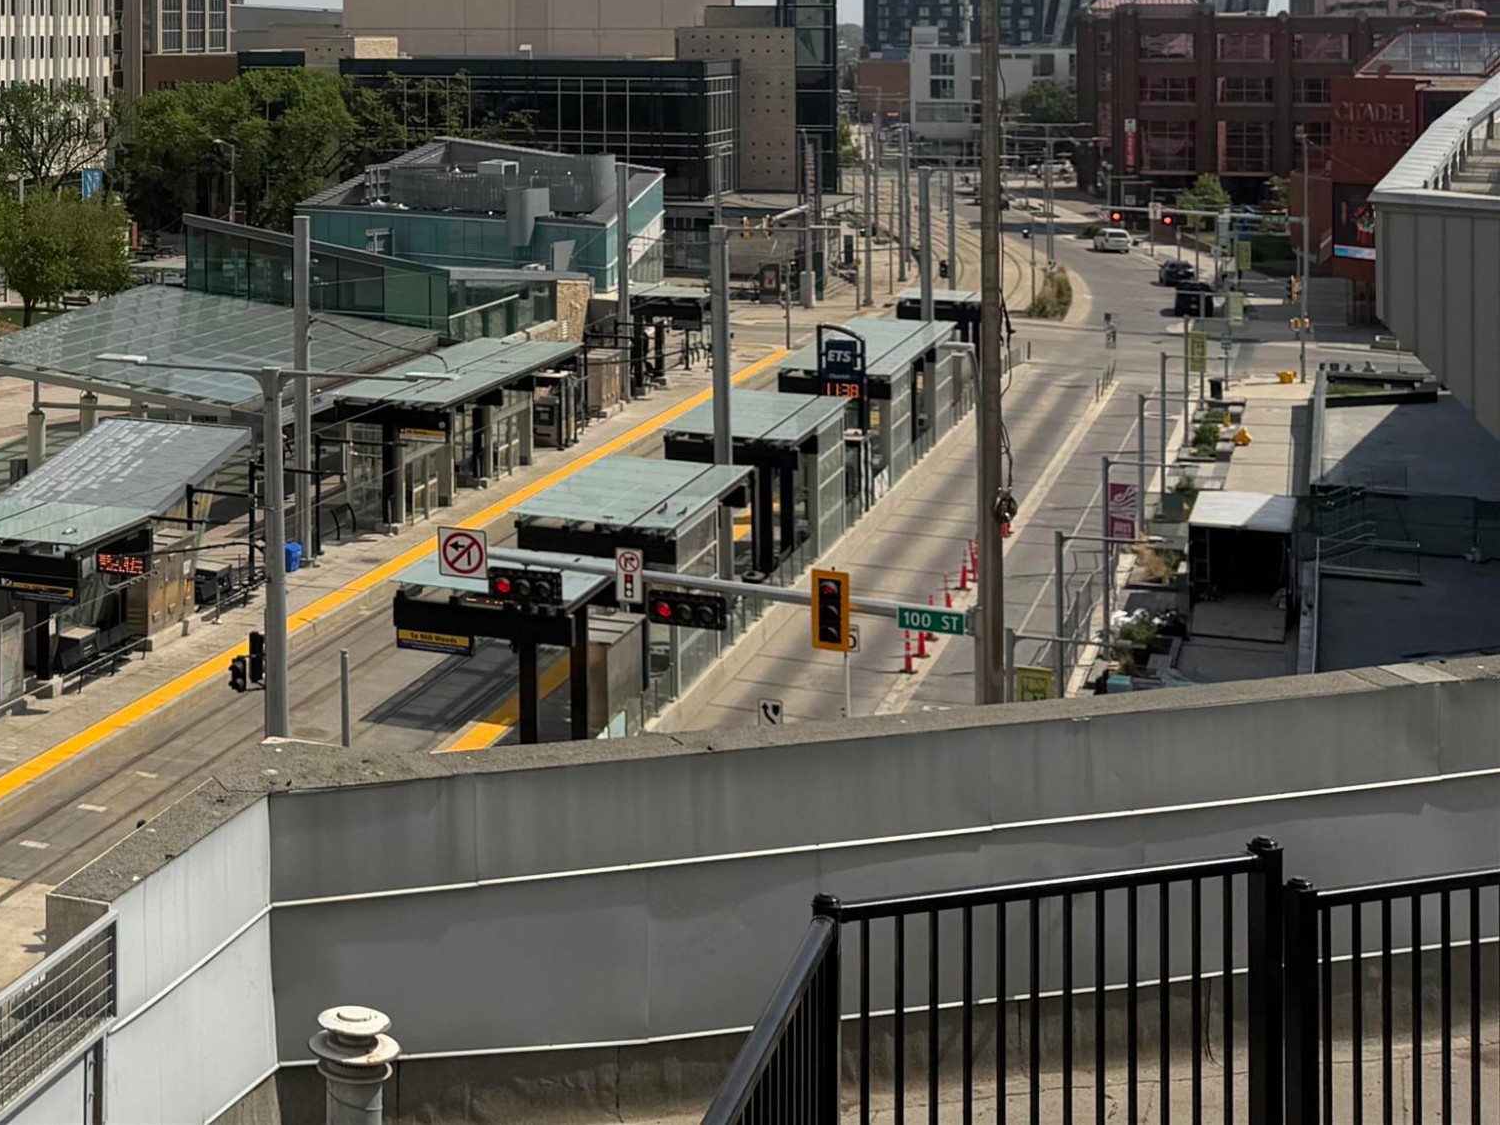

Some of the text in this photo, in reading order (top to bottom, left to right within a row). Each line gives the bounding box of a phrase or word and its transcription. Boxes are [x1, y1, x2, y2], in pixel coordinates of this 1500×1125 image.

[1334, 101, 1410, 123] CITADEL
[1337, 127, 1410, 146] THEATRE
[827, 349, 852, 363] ETS
[903, 611, 960, 631] 100 ST
